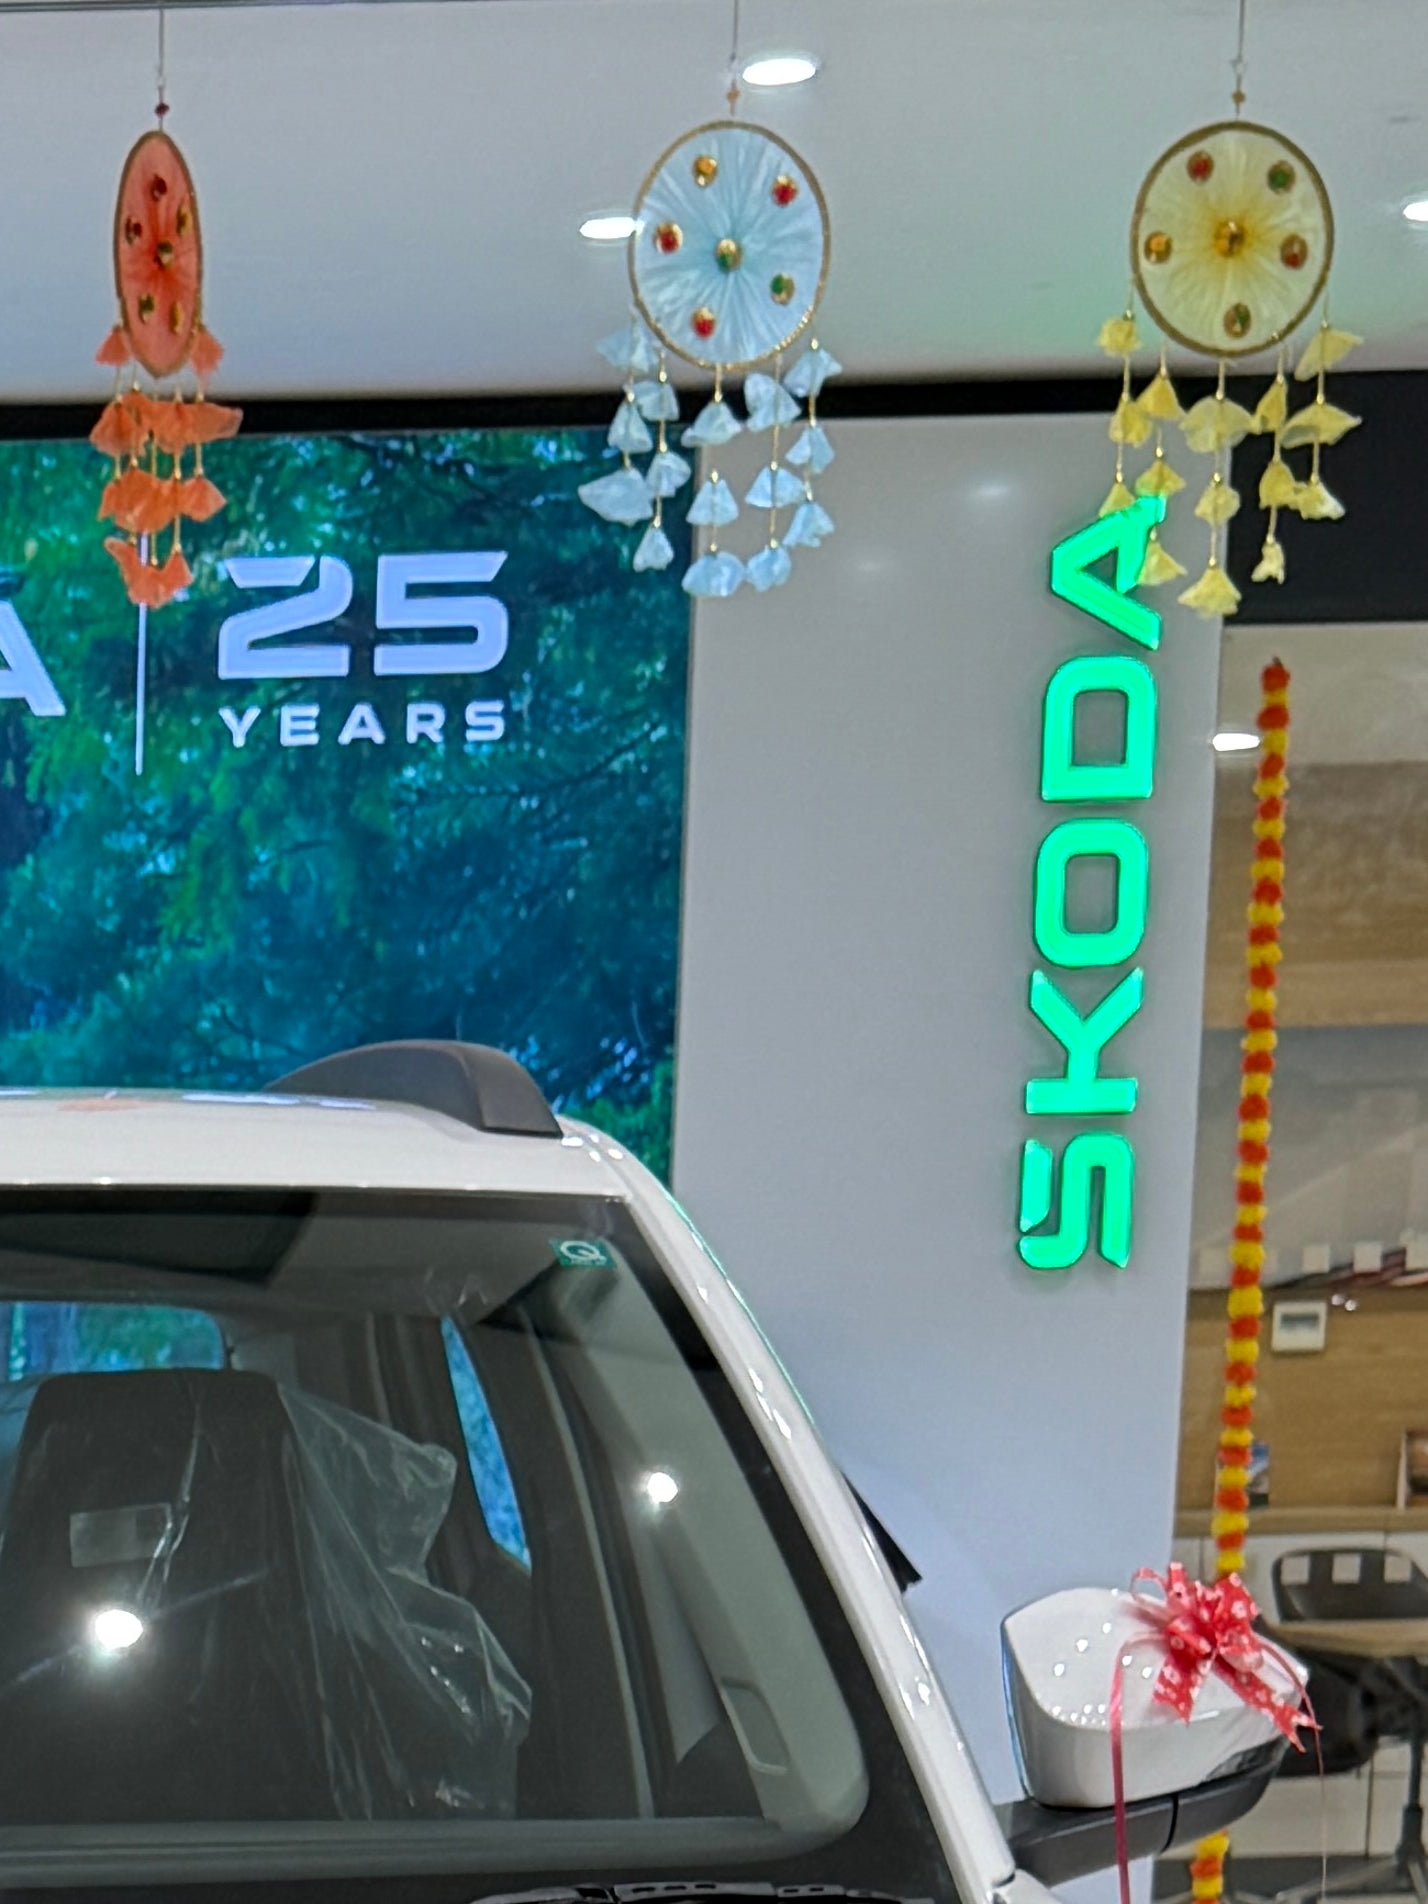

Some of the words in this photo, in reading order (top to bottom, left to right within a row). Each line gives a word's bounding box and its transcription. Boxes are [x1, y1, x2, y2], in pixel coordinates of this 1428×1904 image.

[218, 551, 508, 680] 25
[218, 700, 506, 748] YEARS
[1018, 493, 1166, 1271] SKODA
